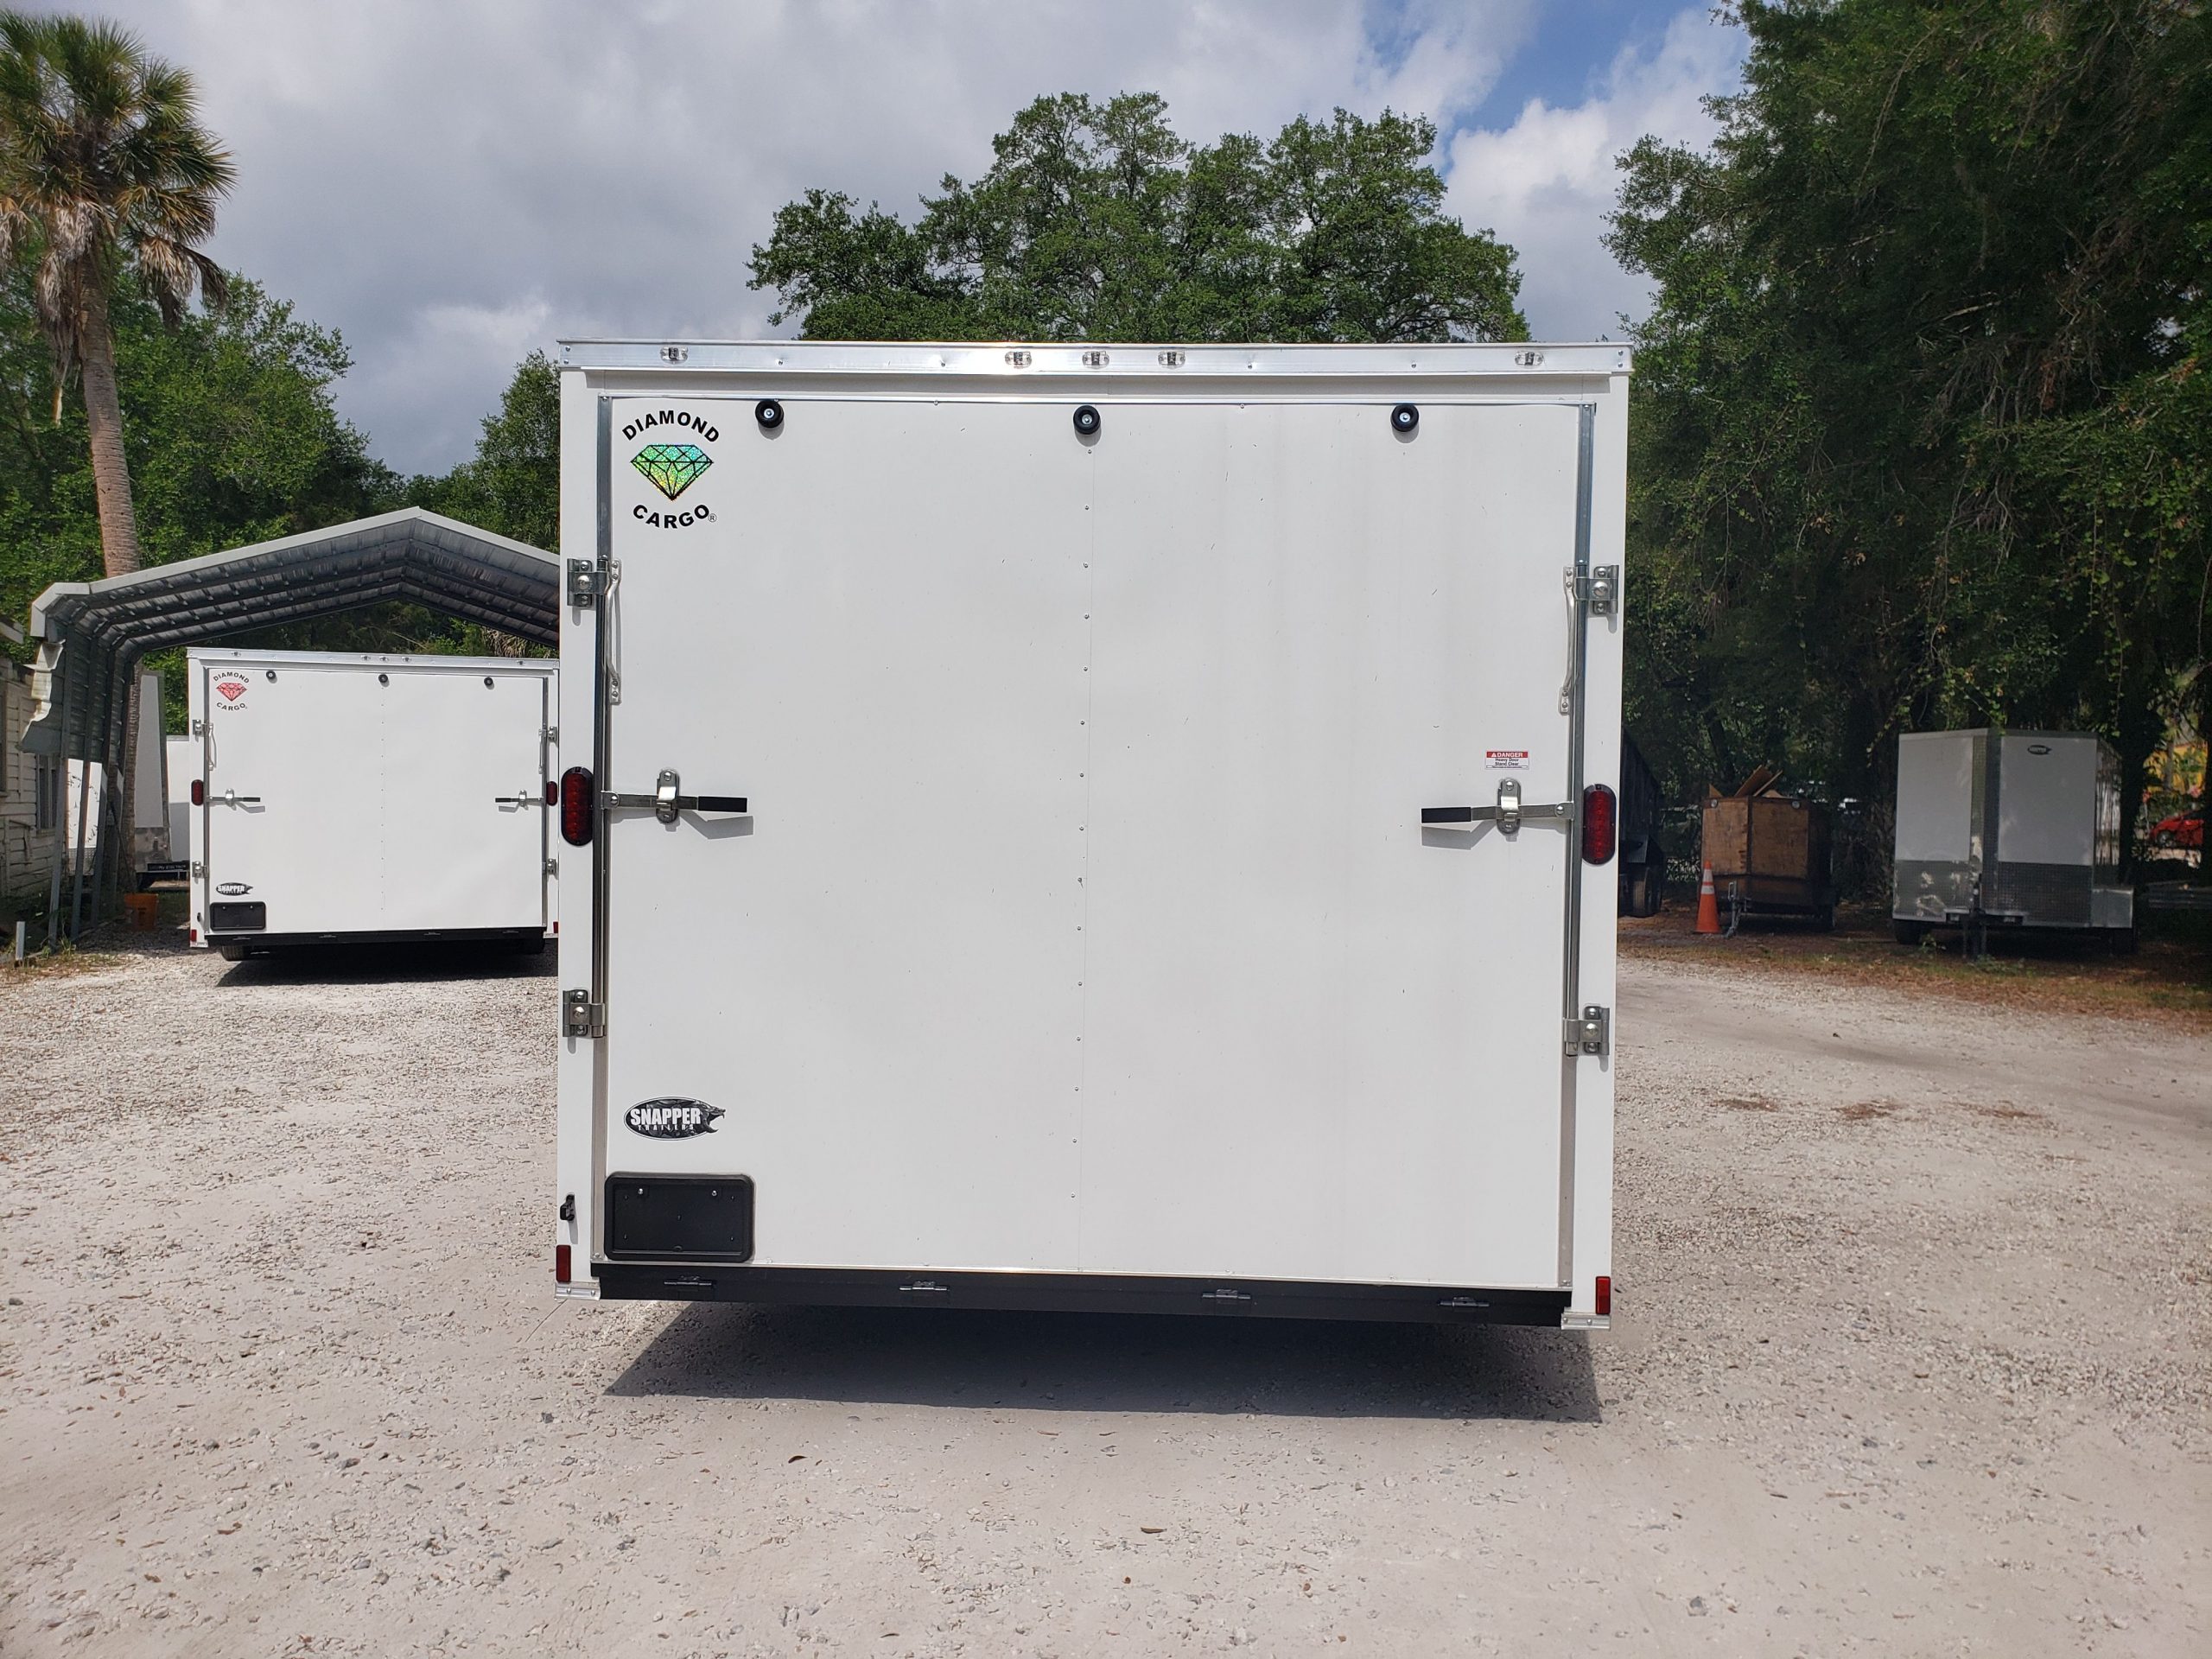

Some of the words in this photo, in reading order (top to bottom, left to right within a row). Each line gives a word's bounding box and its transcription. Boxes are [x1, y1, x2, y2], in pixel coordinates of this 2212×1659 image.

[622, 410, 719, 442] DIAMOND
[213, 671, 250, 683] DIAMOND
[630, 1107, 701, 1125] SNAPPER
